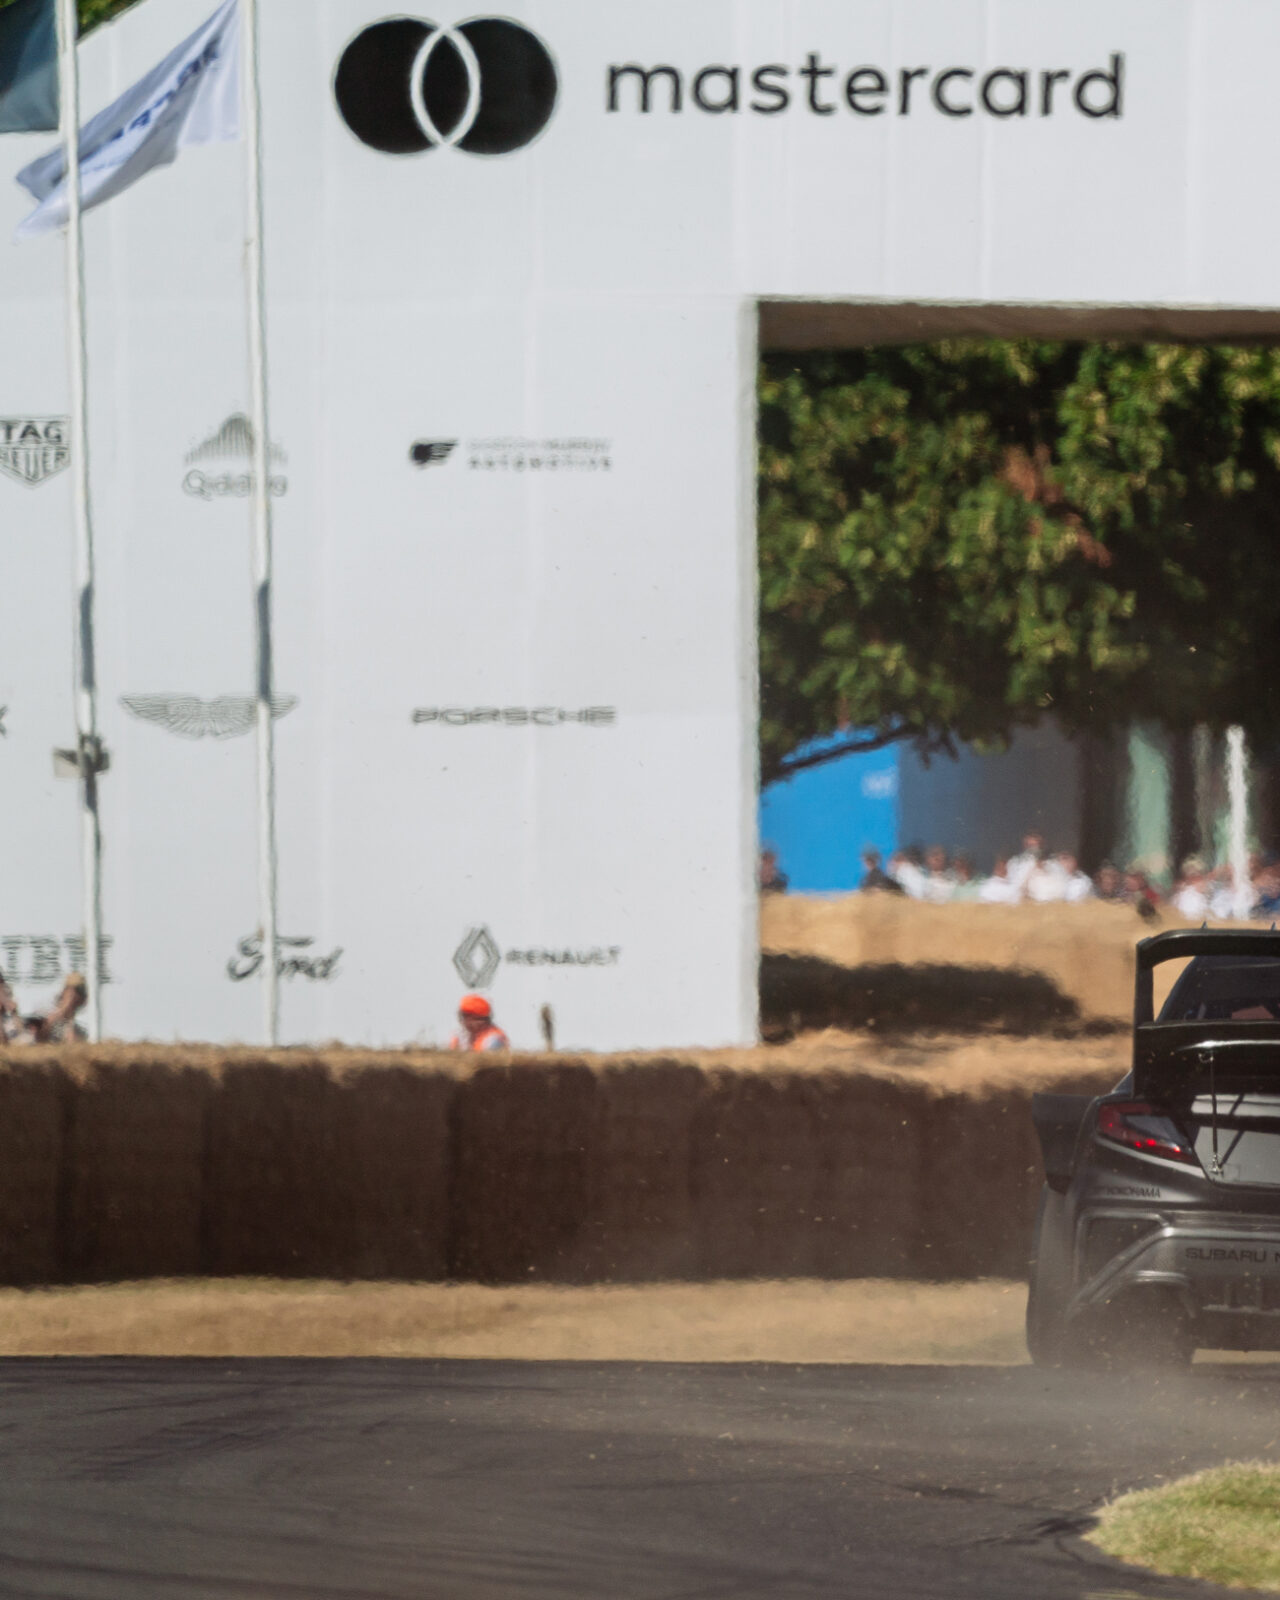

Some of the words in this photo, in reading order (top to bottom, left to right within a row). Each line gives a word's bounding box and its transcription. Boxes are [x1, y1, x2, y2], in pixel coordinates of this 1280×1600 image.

[606, 52, 1124, 117] mastercard
[0, 420, 63, 444] TAG
[412, 706, 616, 726] PORSCHE
[505, 946, 621, 966] RENAULT
[1185, 1247, 1267, 1264] SUBARU
